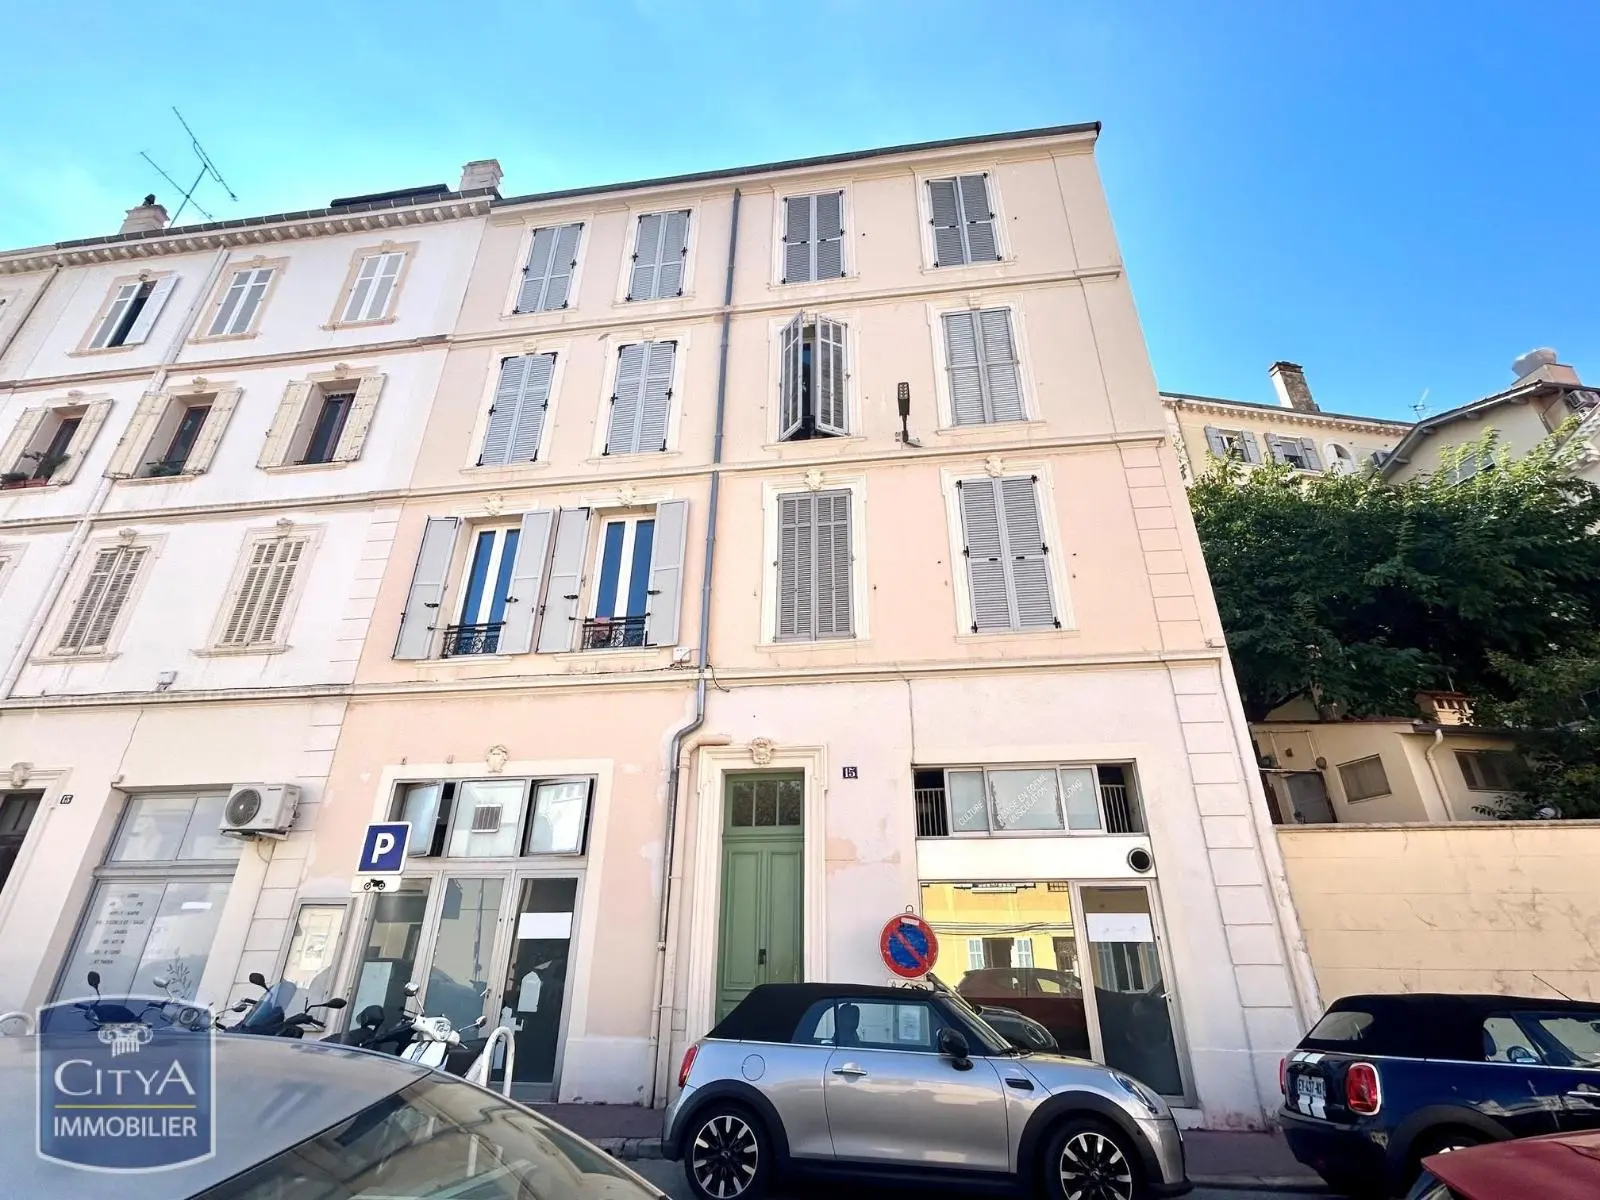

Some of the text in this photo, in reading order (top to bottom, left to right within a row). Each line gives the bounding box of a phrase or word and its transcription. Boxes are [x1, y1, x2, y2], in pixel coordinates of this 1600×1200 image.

[845, 767, 856, 778] 15
[958, 800, 985, 826] CULTURE
[371, 832, 395, 864] P
